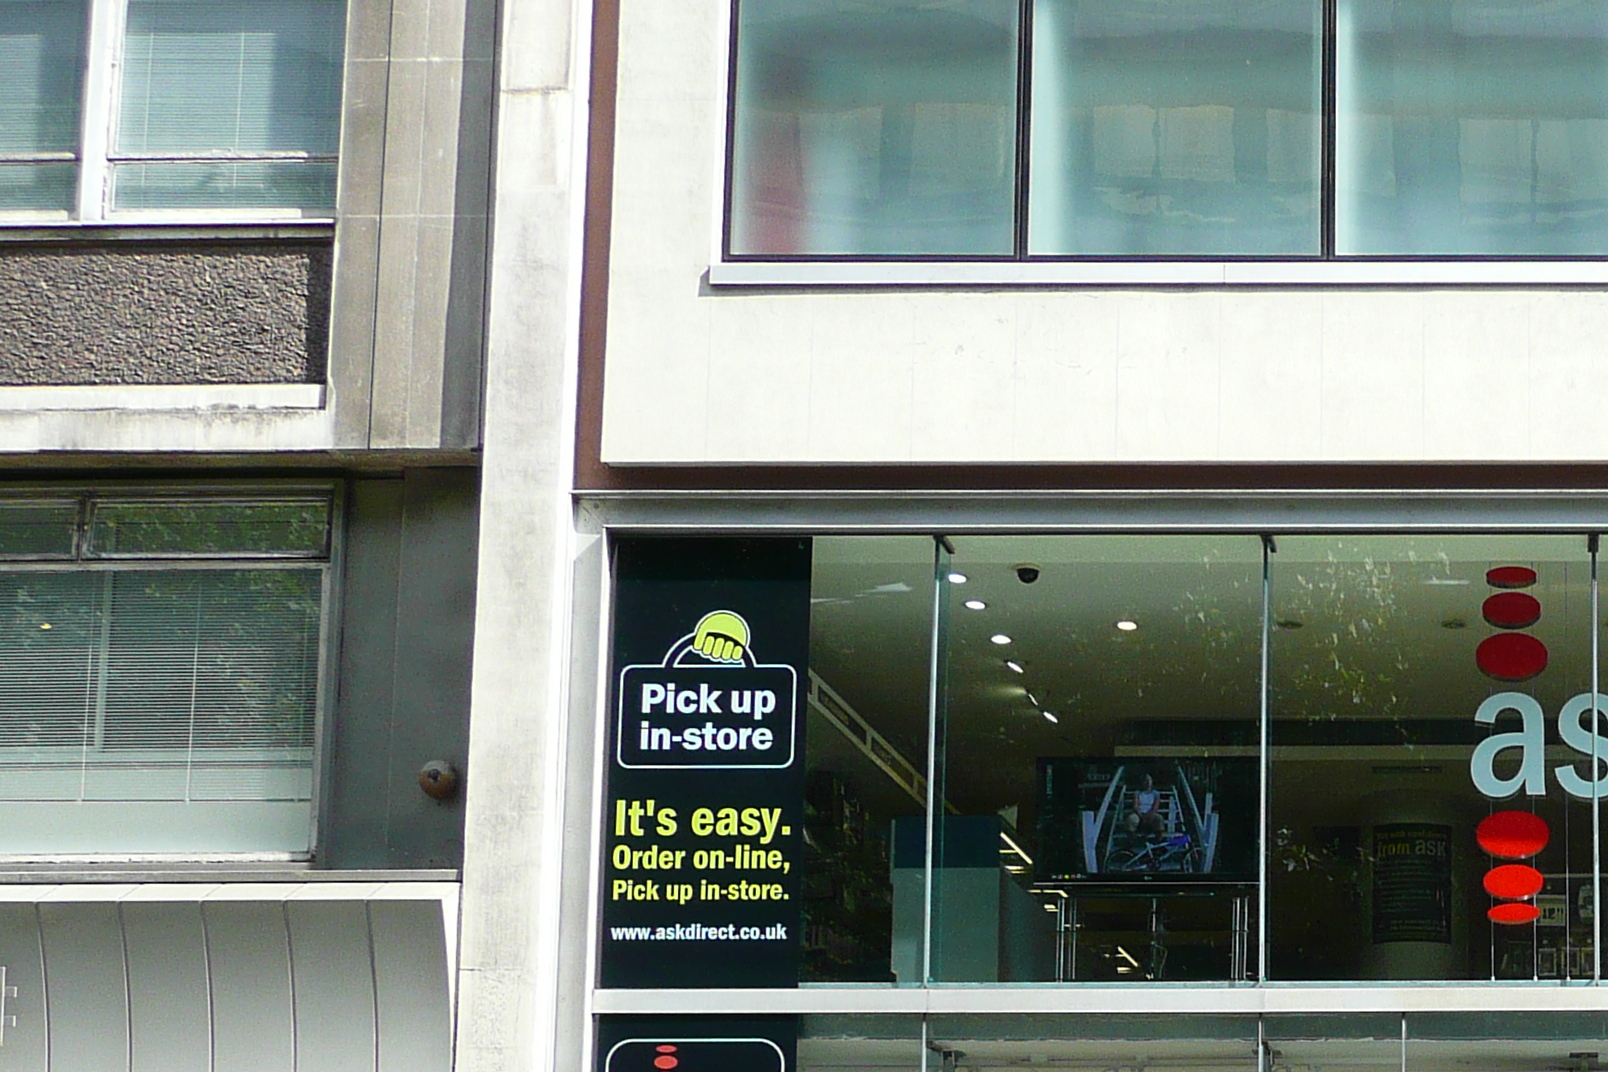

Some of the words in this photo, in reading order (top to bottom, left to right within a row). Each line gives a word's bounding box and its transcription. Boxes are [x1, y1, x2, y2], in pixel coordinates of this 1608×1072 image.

[642, 683, 722, 713] Pick
[731, 690, 775, 720] up
[640, 721, 773, 750] in-store
[616, 800, 677, 836] It's
[692, 808, 790, 844] easy.
[613, 845, 685, 869] Order
[694, 845, 789, 873] on-line,
[613, 880, 659, 900] Pick
[666, 885, 692, 904] up
[701, 880, 788, 900] in-store.
[611, 923, 787, 940] www.askdirect.co.uk
